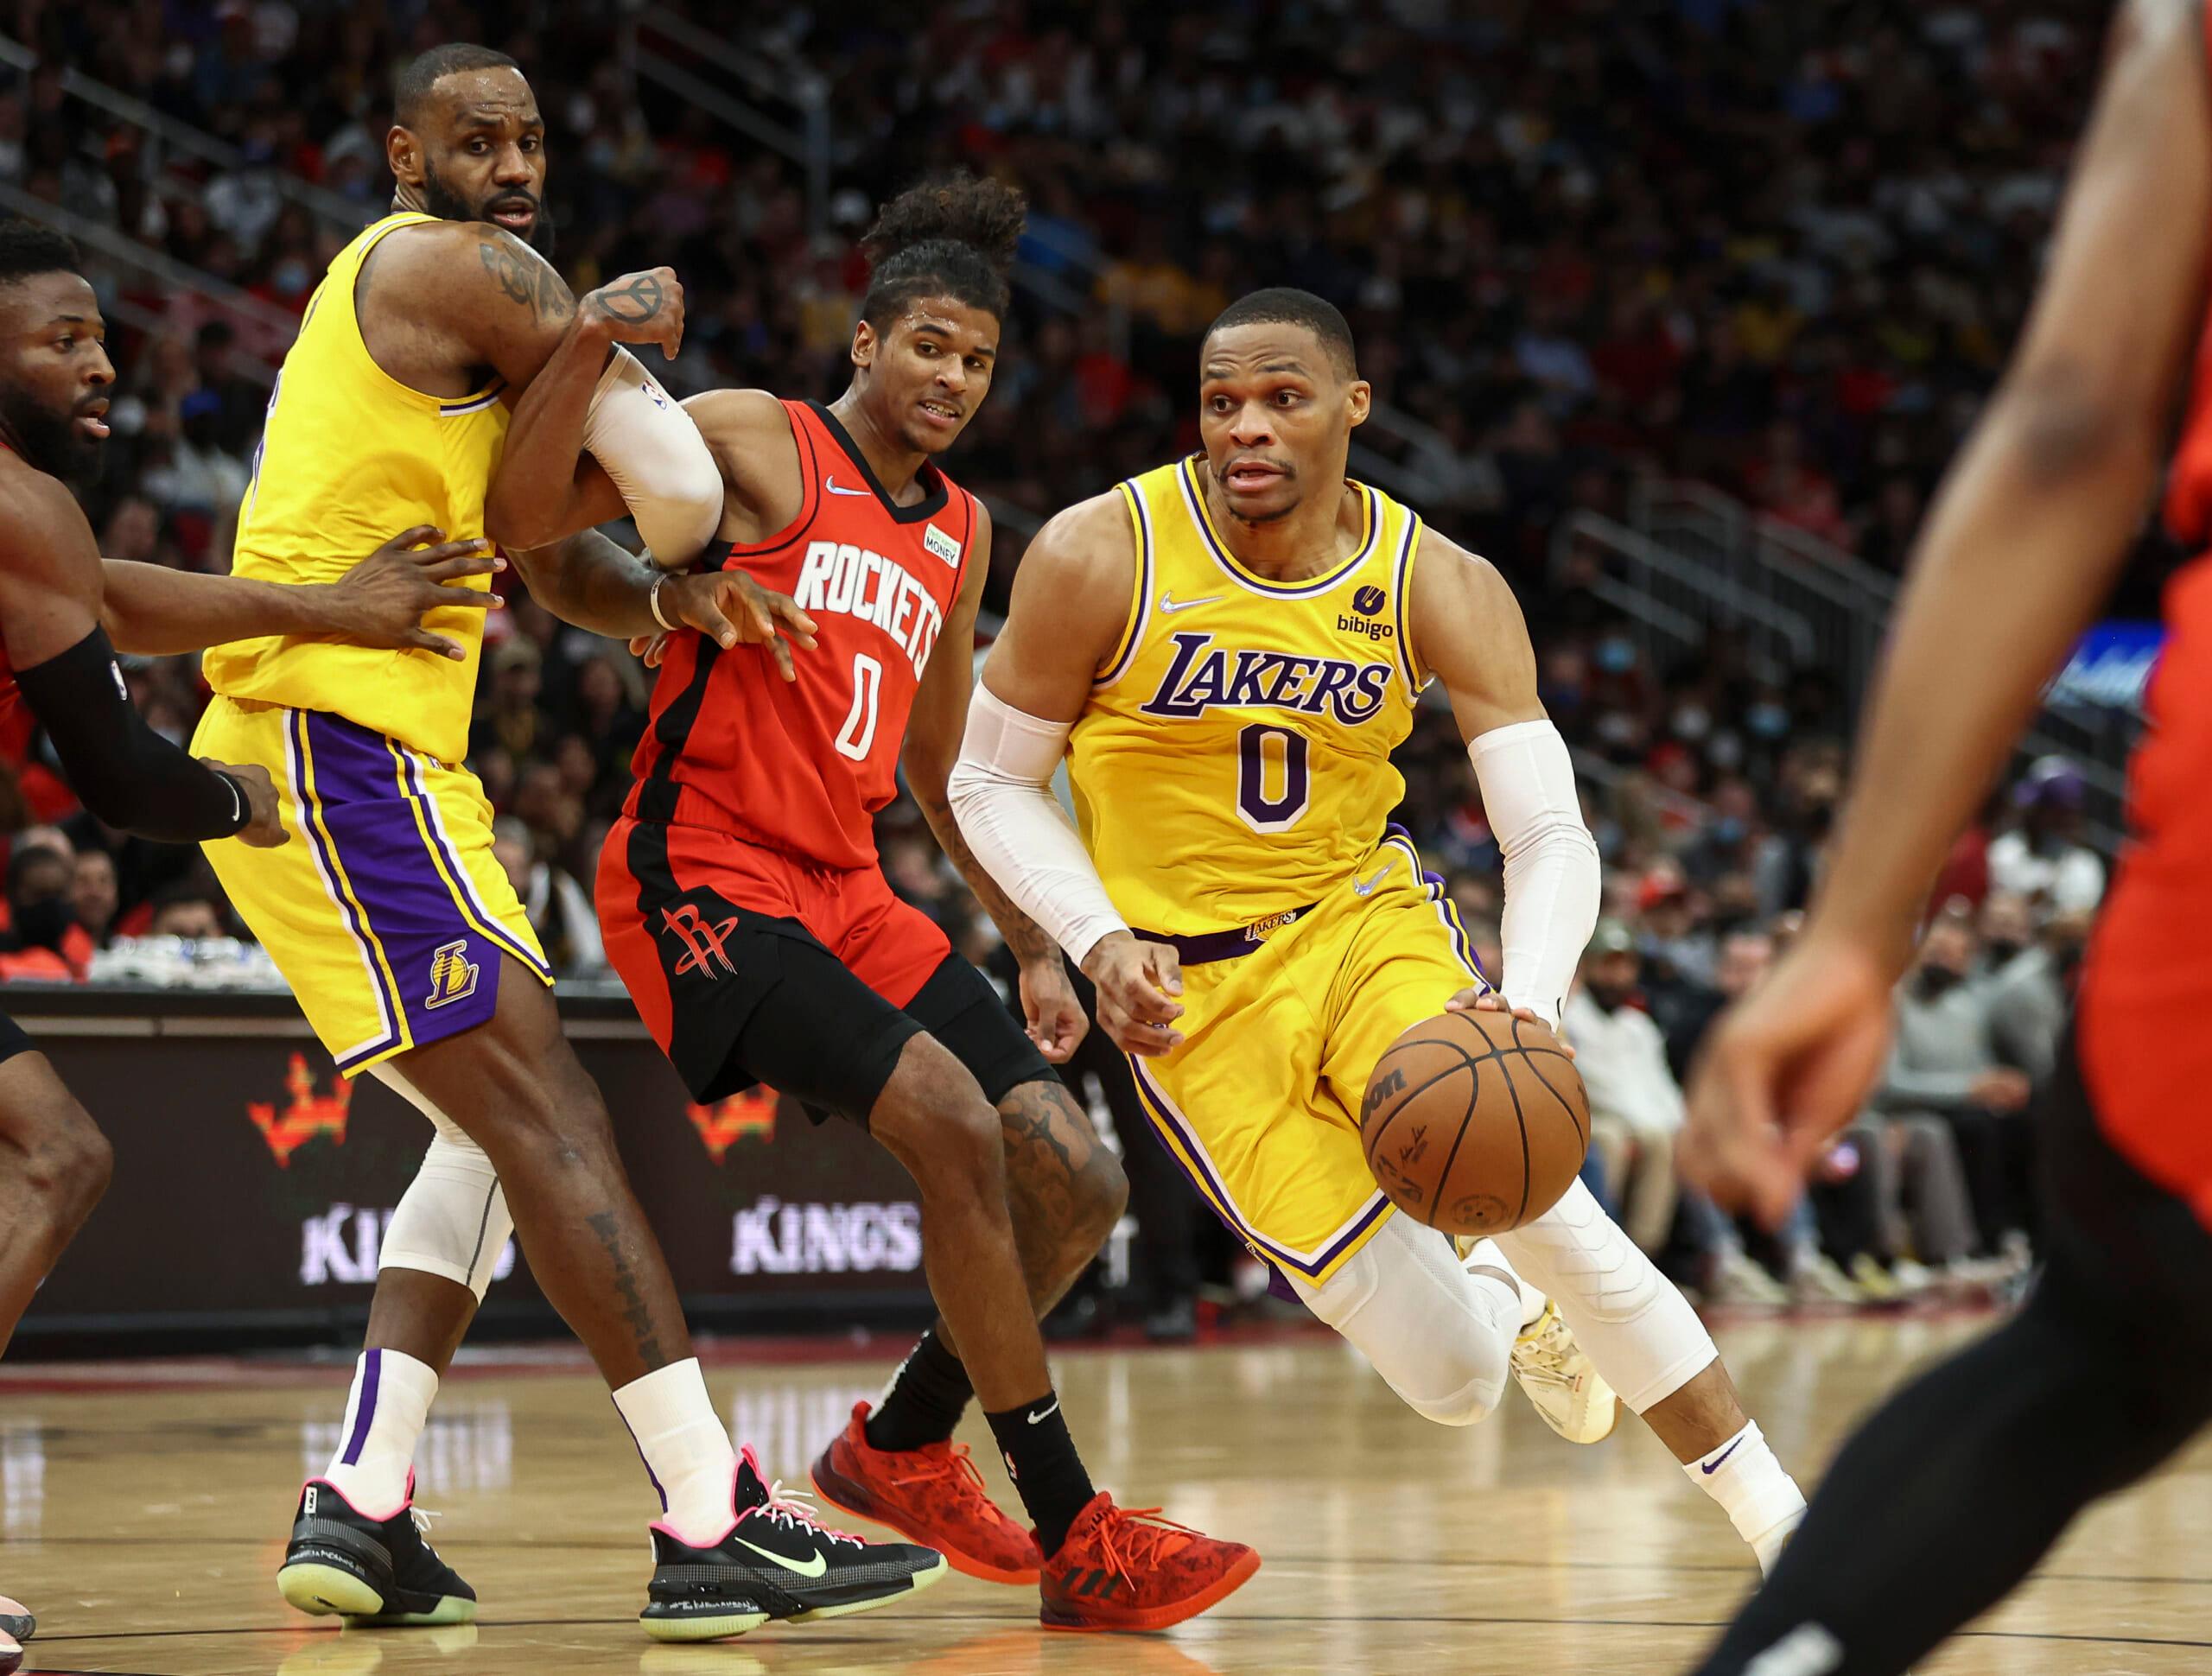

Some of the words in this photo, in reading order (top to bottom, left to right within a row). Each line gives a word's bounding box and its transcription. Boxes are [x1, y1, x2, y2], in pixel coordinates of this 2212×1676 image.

[925, 536, 956, 564] MONEY
[793, 541, 943, 682] ROCKETS
[1337, 614, 1394, 641] bibigo
[835, 652, 882, 762] 0
[1137, 631, 1395, 727] LAKERS
[1236, 722, 1312, 835] 0
[1244, 910, 1297, 942] LAKERS
[731, 1195, 923, 1275] KINGS
